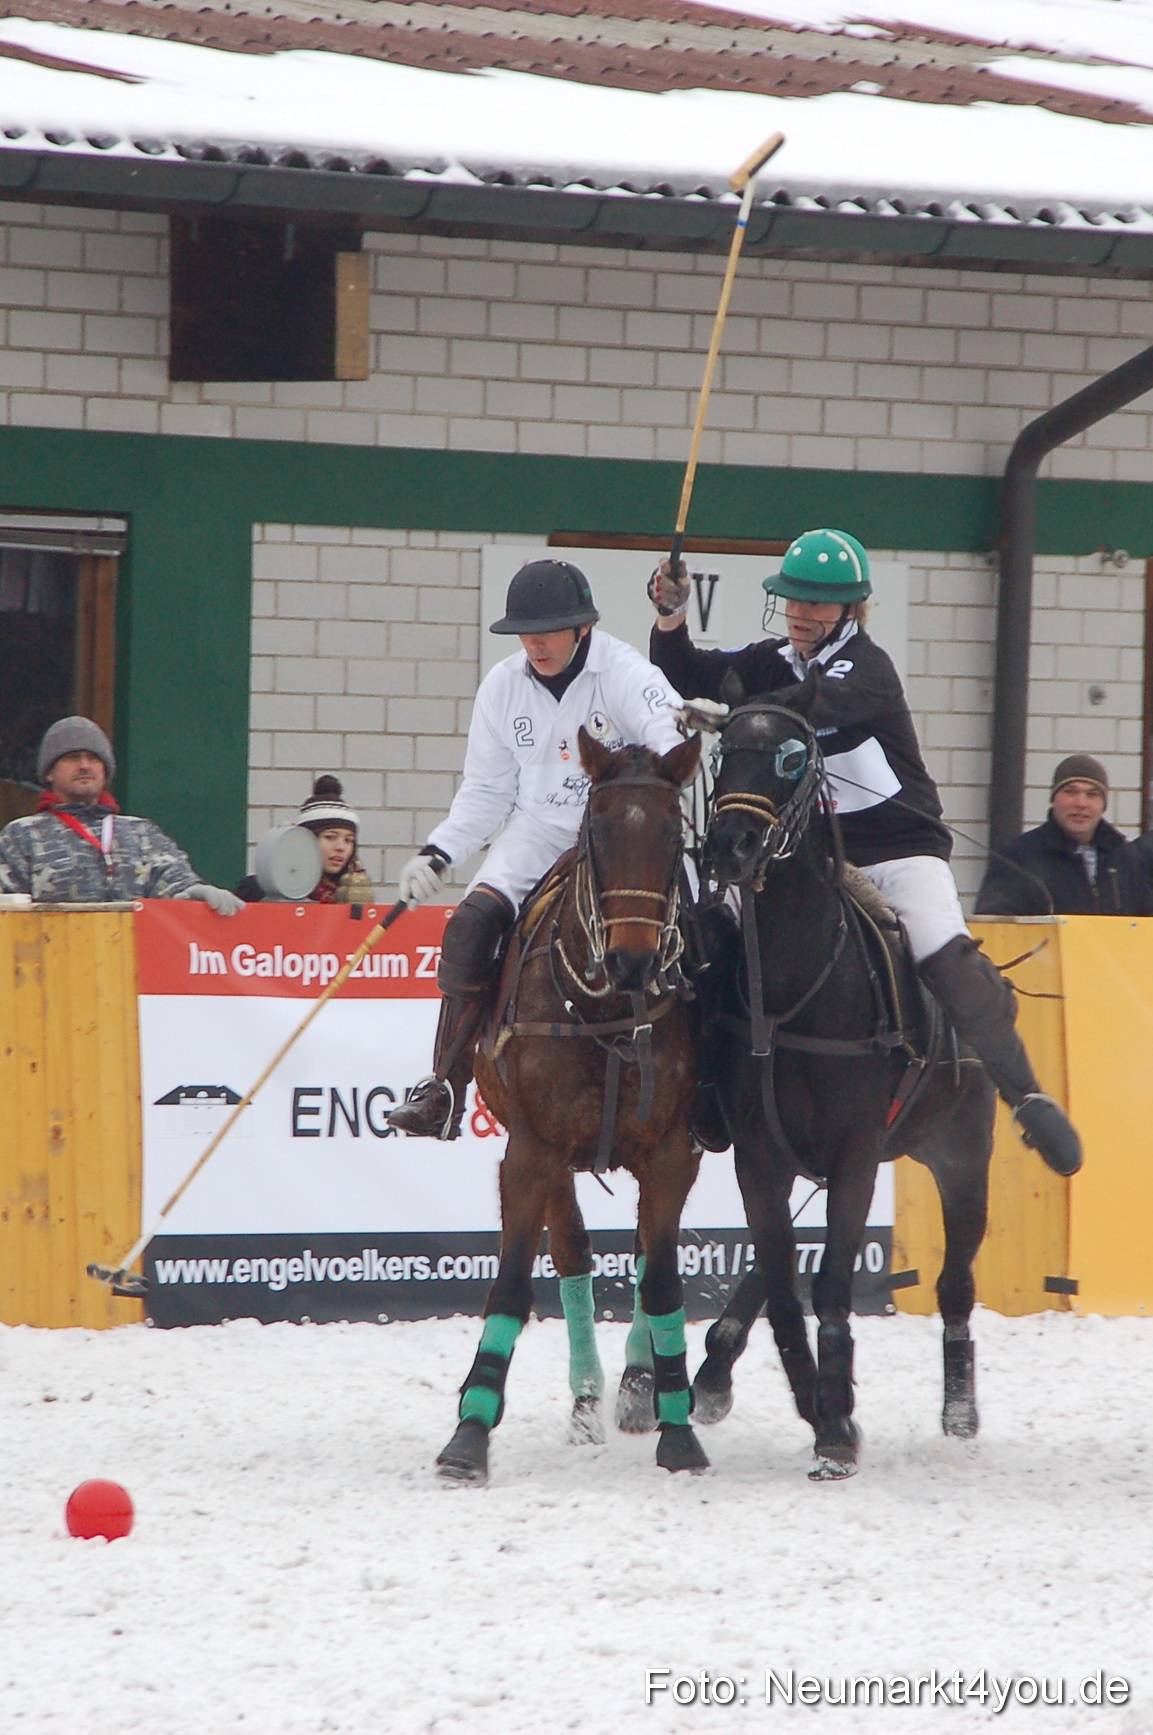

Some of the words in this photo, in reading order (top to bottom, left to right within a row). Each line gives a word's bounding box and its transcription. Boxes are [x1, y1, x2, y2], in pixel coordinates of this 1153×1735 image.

[826, 659, 854, 679] 2
[643, 686, 668, 714] 2
[513, 716, 535, 747] 2
[189, 942, 228, 975] Im
[231, 943, 340, 986] Galopp
[345, 953, 409, 978] zum
[292, 1086, 461, 1138] ENG
[154, 1249, 500, 1291] www.engelvoelkers.com
